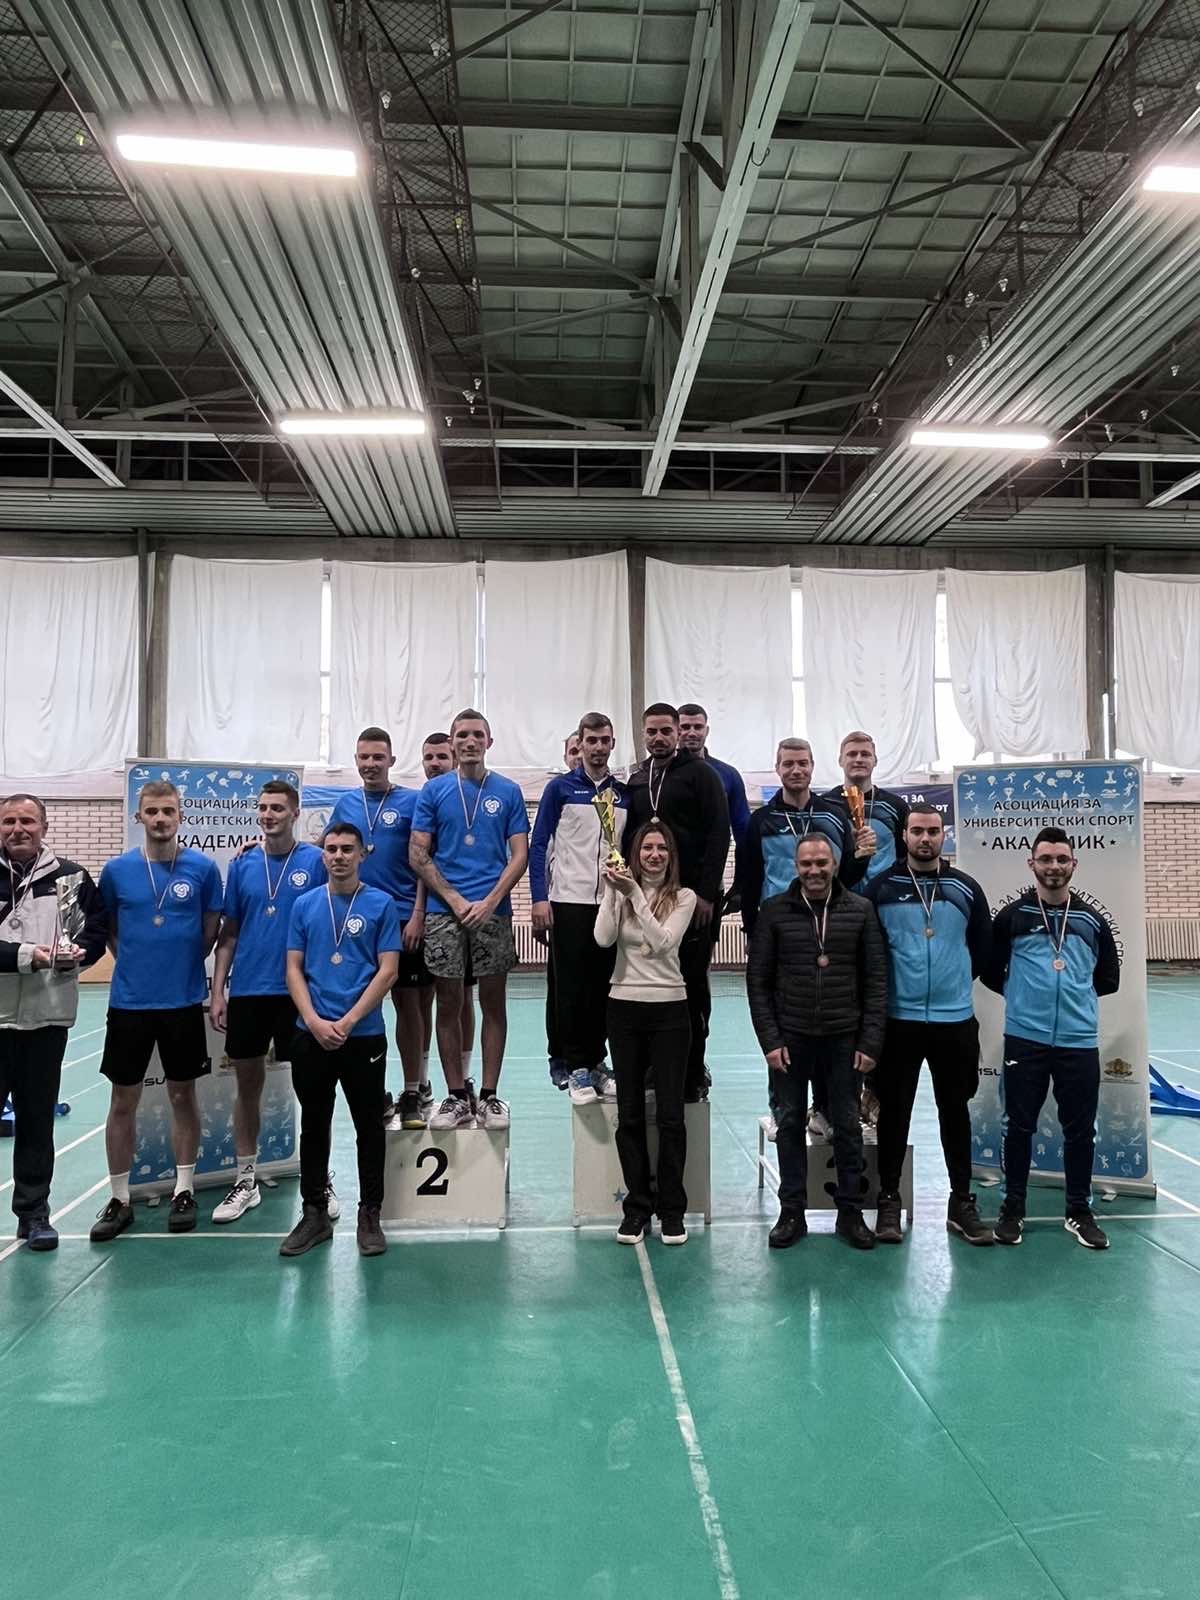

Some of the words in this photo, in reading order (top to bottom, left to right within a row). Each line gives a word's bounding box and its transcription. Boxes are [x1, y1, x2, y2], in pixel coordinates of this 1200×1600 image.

[993, 798, 1079, 812] АСОЦИАЦИЯ
[1085, 798, 1102, 809] ЗА
[963, 815, 1085, 828] УНИВЕРСИТЕТСКИ
[1089, 815, 1135, 826] СПОРТ
[415, 1147, 449, 1196] 2
